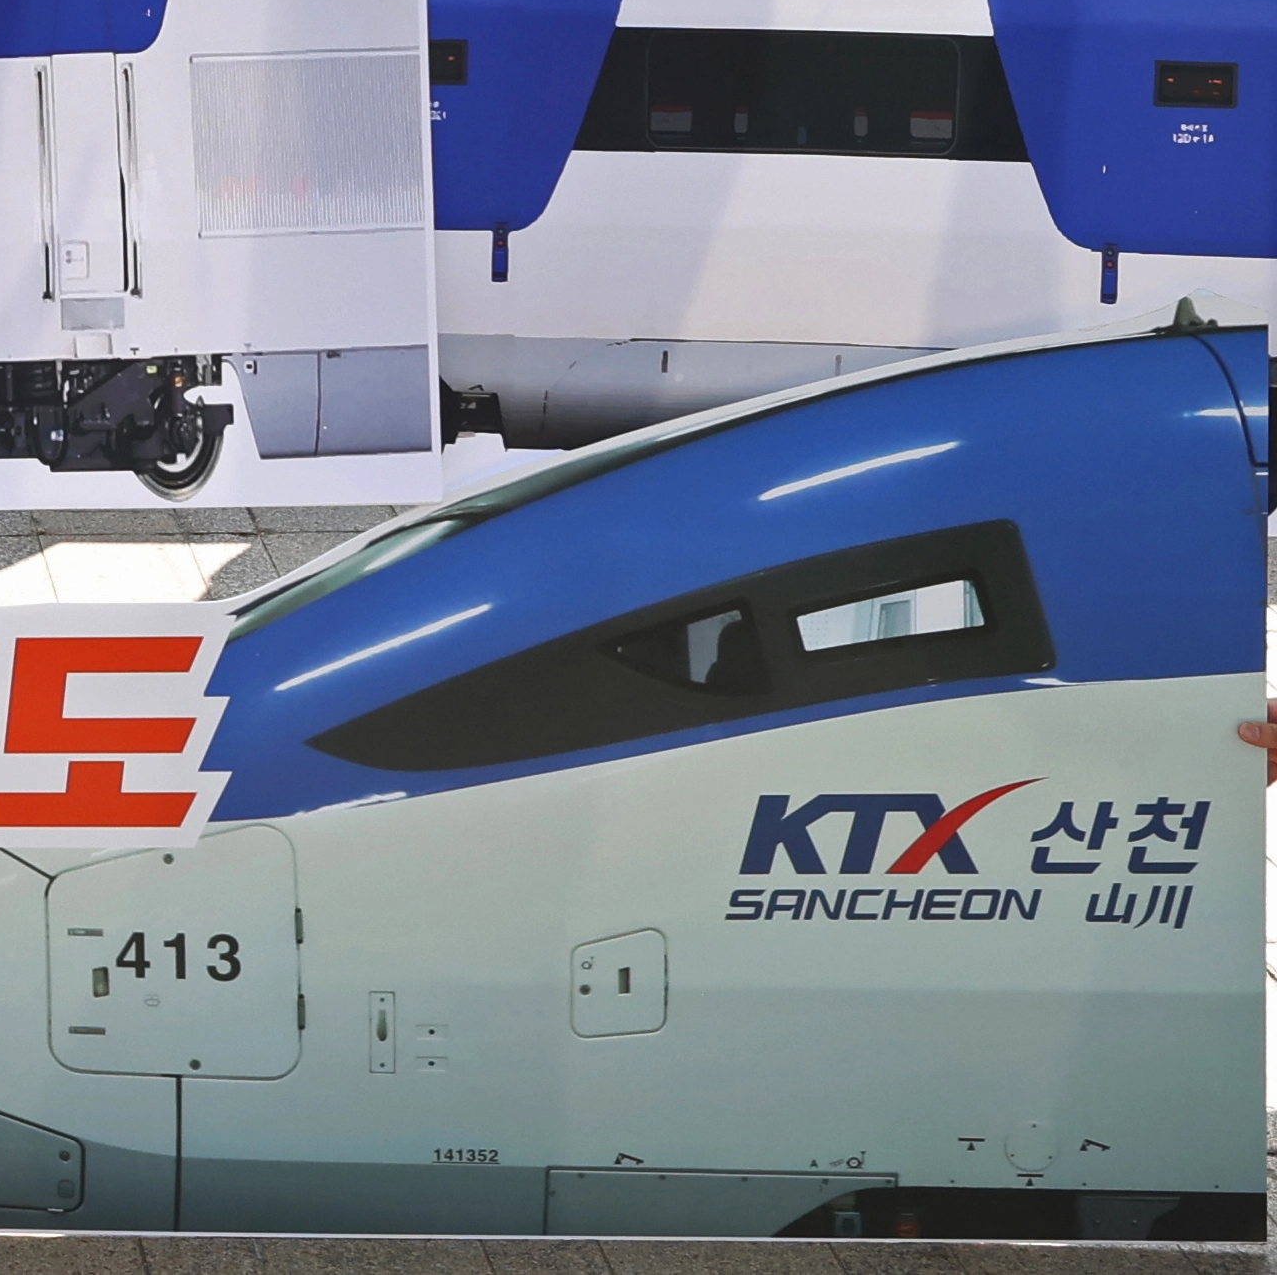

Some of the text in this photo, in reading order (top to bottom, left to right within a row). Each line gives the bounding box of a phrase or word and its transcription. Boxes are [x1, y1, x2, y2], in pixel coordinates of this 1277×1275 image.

[737, 778, 1211, 877] KTX 산천
[724, 881, 1193, 931] SANCHEON 山川
[115, 931, 242, 982] 413
[433, 1147, 499, 1162] 141352
